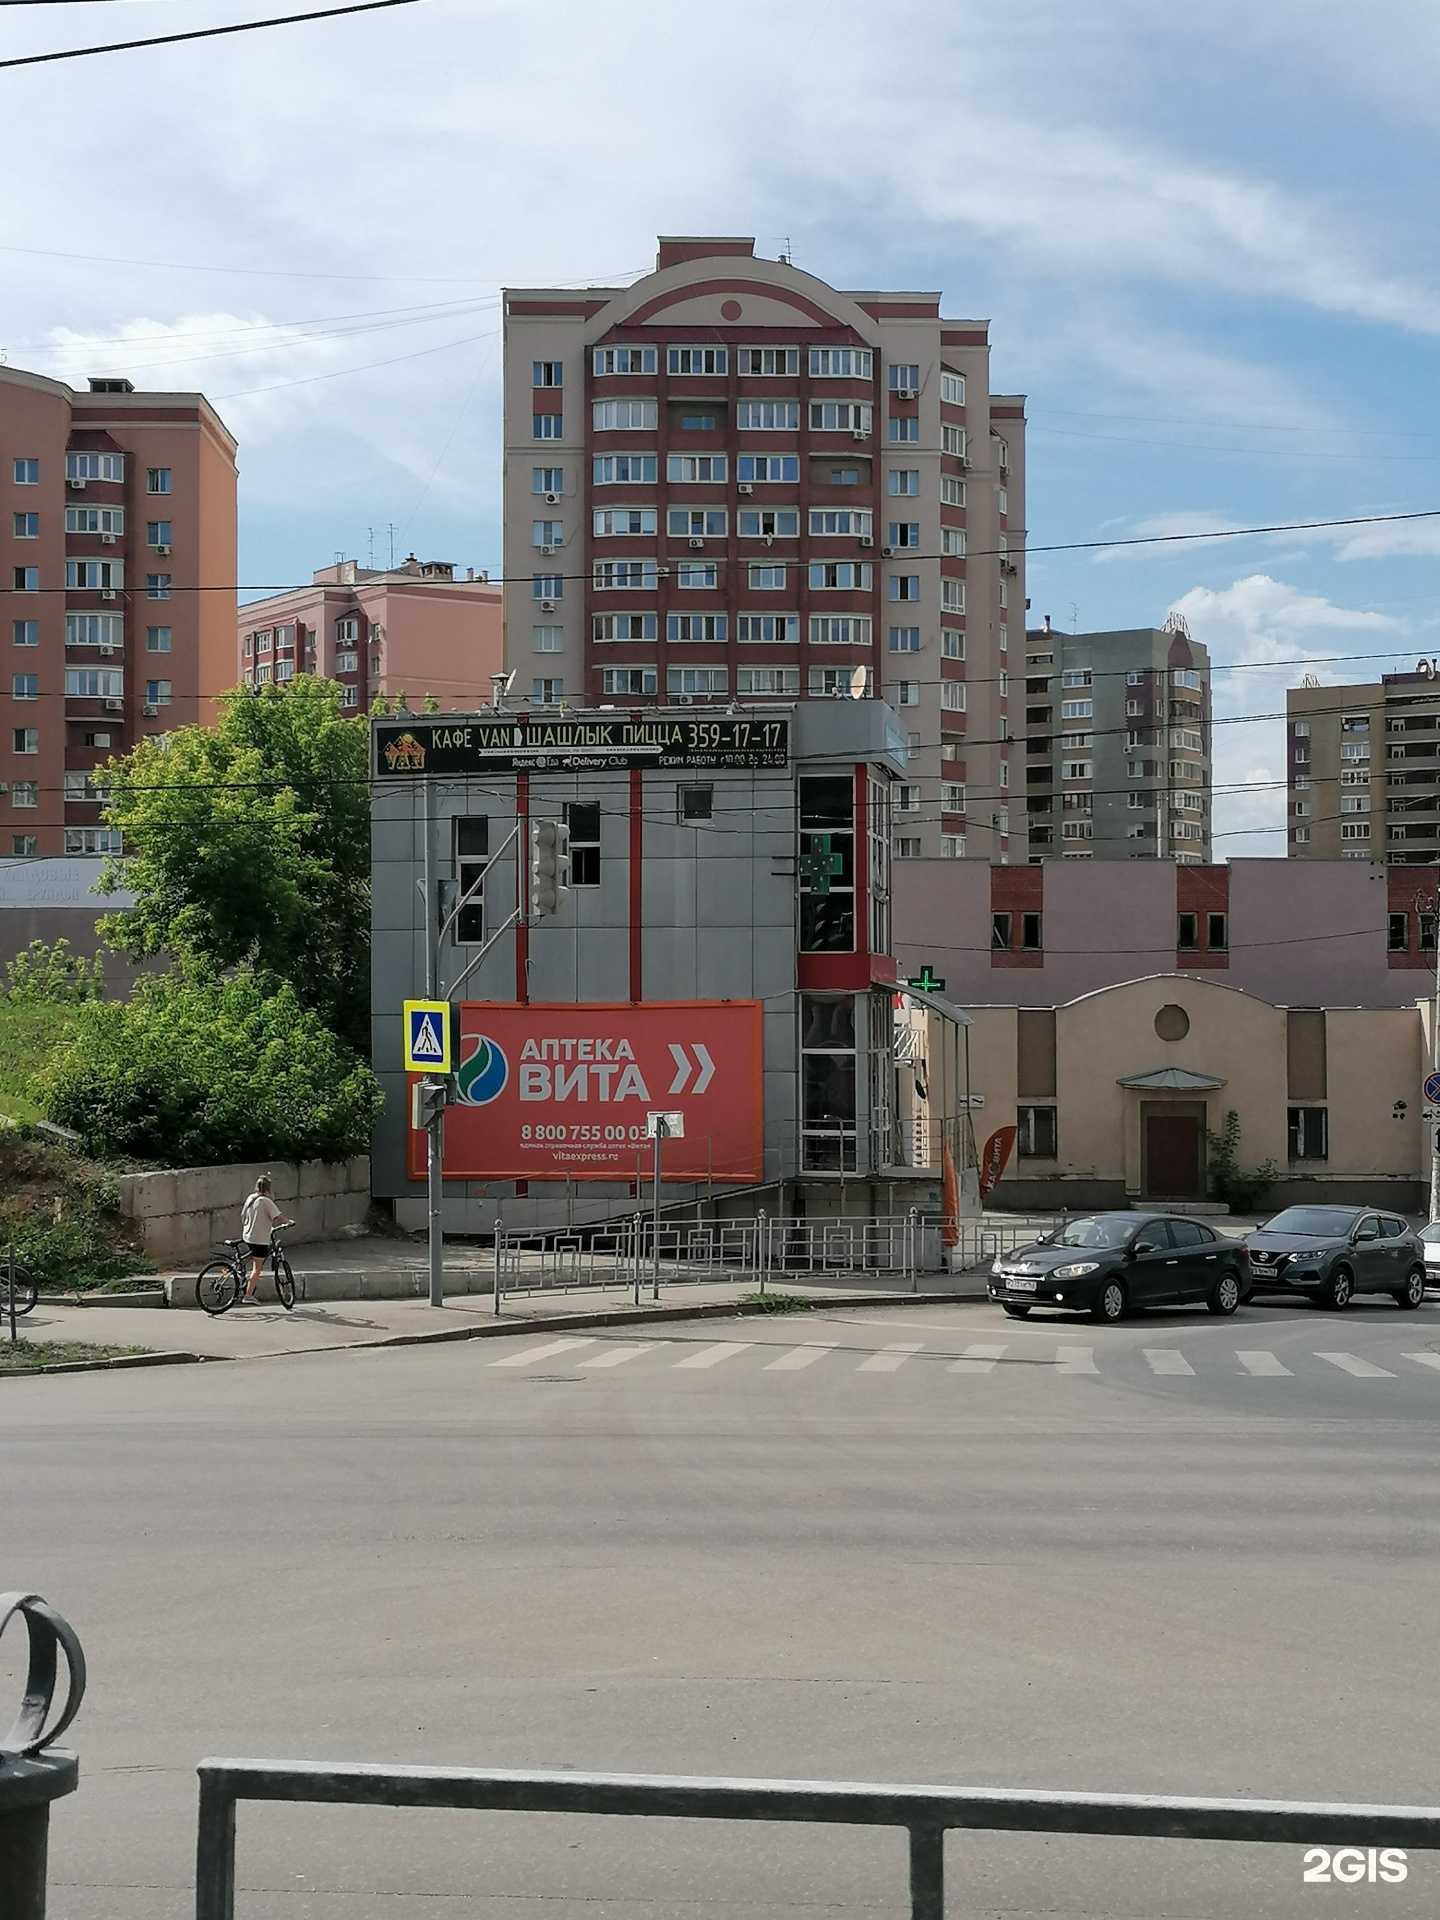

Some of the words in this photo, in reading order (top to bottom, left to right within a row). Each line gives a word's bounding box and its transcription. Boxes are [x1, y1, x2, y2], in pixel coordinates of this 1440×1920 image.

[432, 728, 473, 749] КАФЕ
[479, 727, 510, 748] VAN
[526, 724, 614, 747] ШАШЛЫК
[622, 724, 683, 746] ПИЦЦА
[687, 722, 782, 748] 359-17-17
[572, 755, 607, 769] Delivery
[608, 756, 628, 766] Club
[686, 754, 717, 766] РАБОТЫ
[519, 1038, 636, 1061] АПТЕКА
[519, 1063, 652, 1102] ВИТА
[521, 1124, 532, 1140] 8
[535, 1124, 567, 1140] 800
[570, 1125, 601, 1140] 755
[604, 1125, 626, 1140] 00
[629, 1125, 649, 1140] 03
[552, 1151, 619, 1162] vitaexpress.ru
